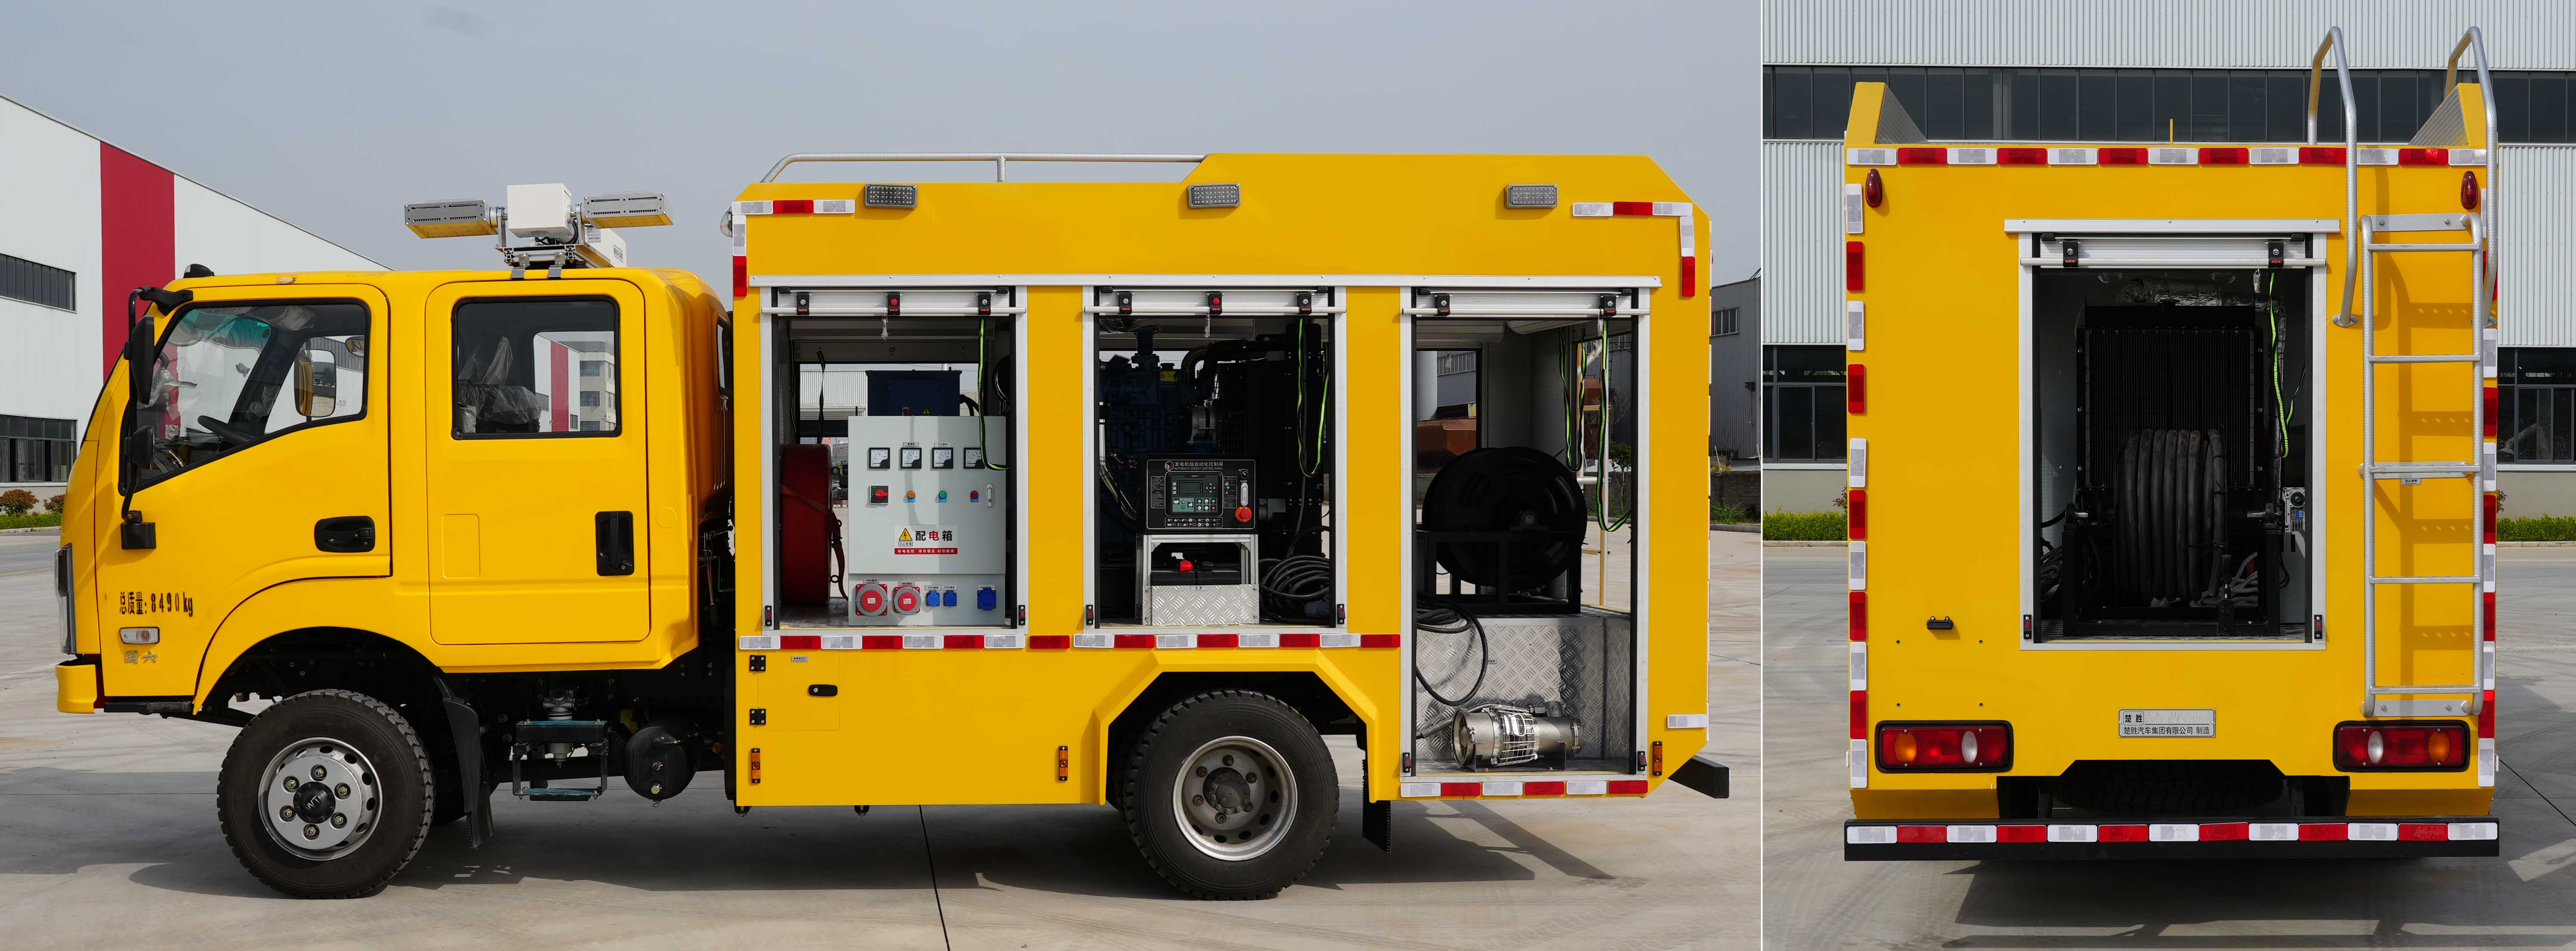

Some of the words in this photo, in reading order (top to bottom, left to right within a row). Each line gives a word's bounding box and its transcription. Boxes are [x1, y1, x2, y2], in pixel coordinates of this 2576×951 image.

[915, 530, 953, 541] 配电箱
[124, 650, 159, 663] 国六
[2125, 714, 2143, 723] 楚胜
[2123, 727, 2193, 735] 楚胜汽车集团有限公司
[2196, 726, 2210, 734] 制造
